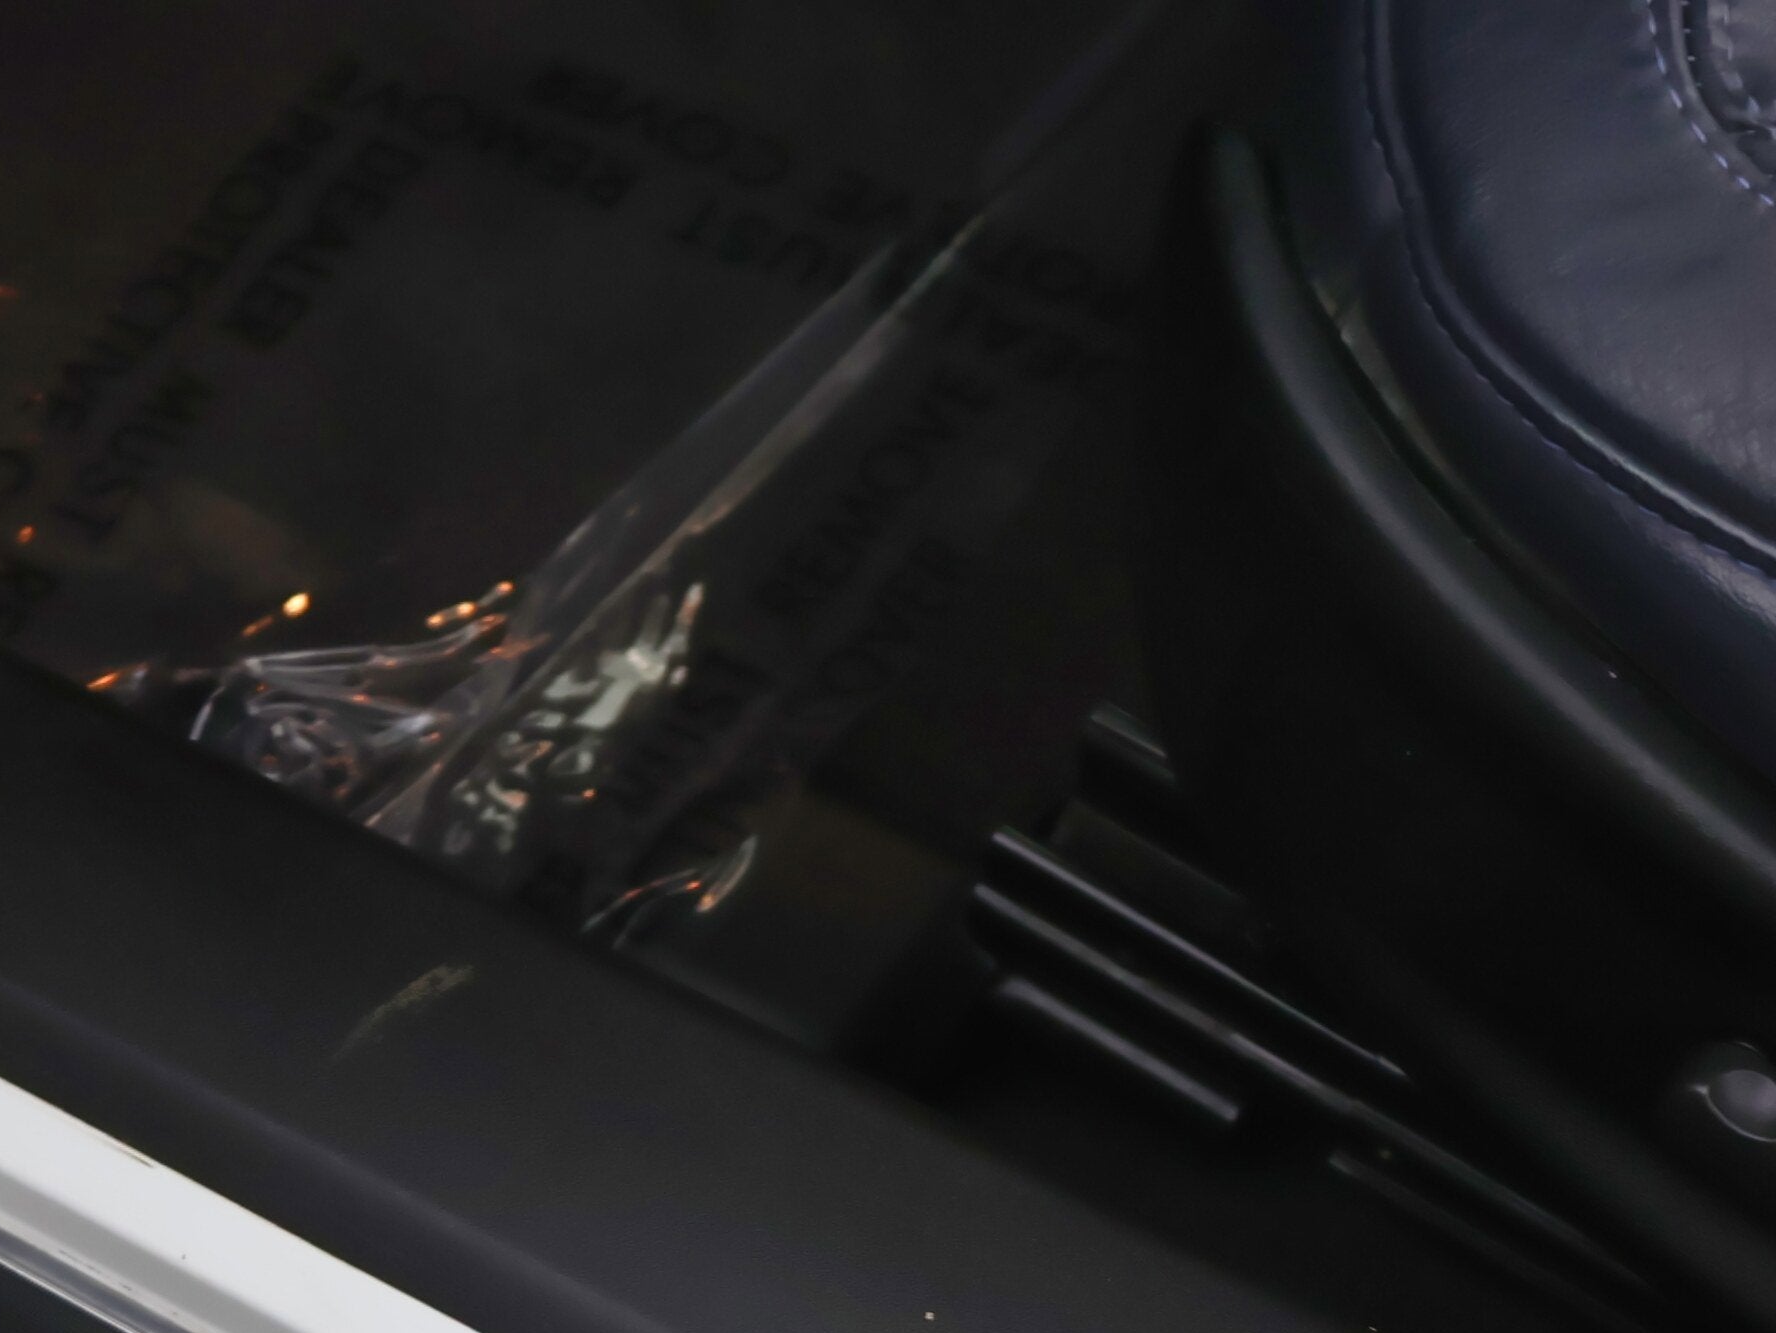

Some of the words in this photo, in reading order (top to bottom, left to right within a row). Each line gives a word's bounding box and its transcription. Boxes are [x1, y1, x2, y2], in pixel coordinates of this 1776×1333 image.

[44, 103, 336, 432] PROTECTIVE
[224, 138, 426, 350] DEALER
[46, 378, 214, 545] MUST
[754, 365, 999, 615] REMOVE
